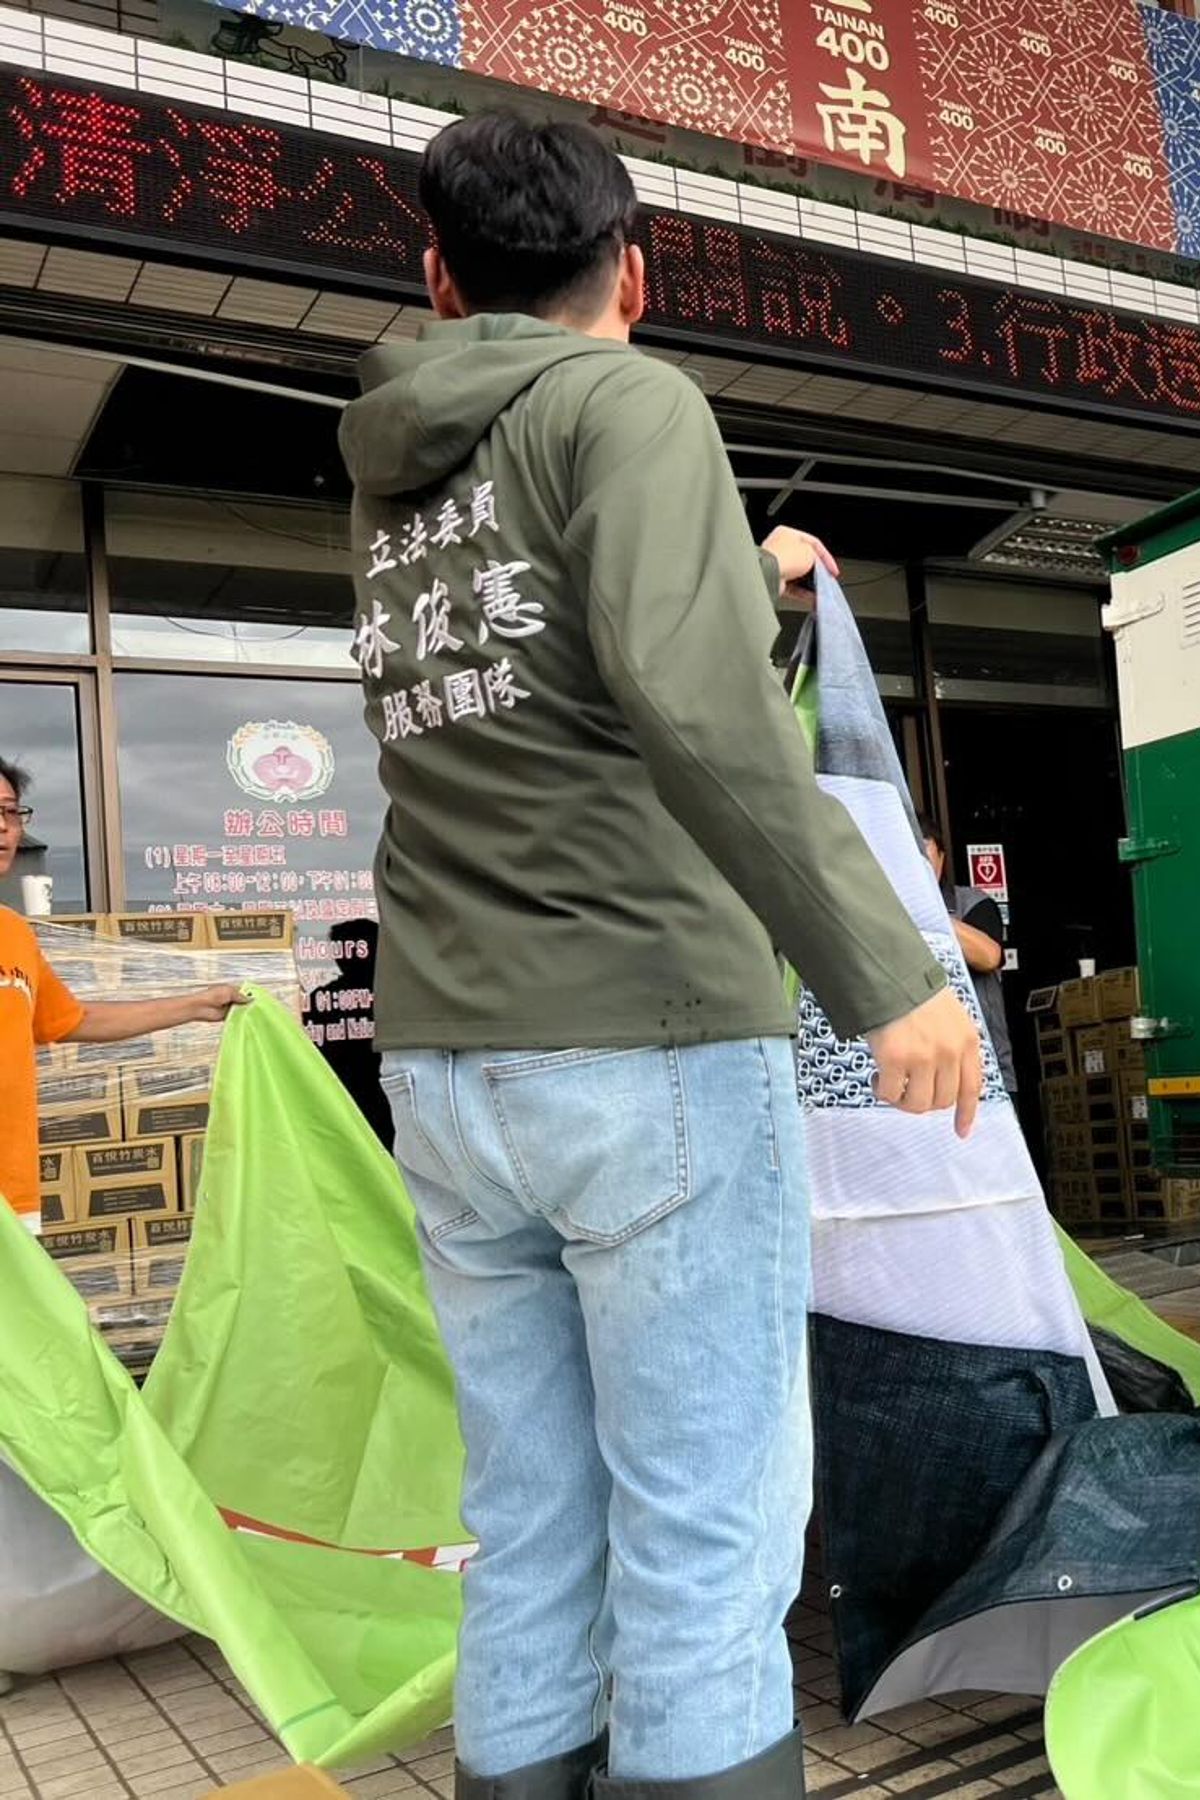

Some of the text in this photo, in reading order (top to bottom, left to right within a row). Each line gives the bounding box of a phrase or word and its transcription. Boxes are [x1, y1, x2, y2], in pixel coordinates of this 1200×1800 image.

[603, 11, 648, 36] 400
[810, 4, 885, 40] TAINAN
[924, 7, 958, 28] 400
[724, 47, 766, 72] 400
[816, 27, 890, 71] 400
[1019, 37, 1052, 57] 400
[1107, 64, 1139, 83] 400
[815, 67, 906, 179] 南
[938, 109, 974, 131] 400
[1034, 136, 1067, 156] 400
[1123, 160, 1153, 179] 400
[366, 480, 500, 578] 立法委員
[355, 559, 546, 680] 林俊憲
[382, 656, 532, 742] 服務團隊
[224, 809, 348, 837] 辦公時間
[298, 937, 369, 960] Hours
